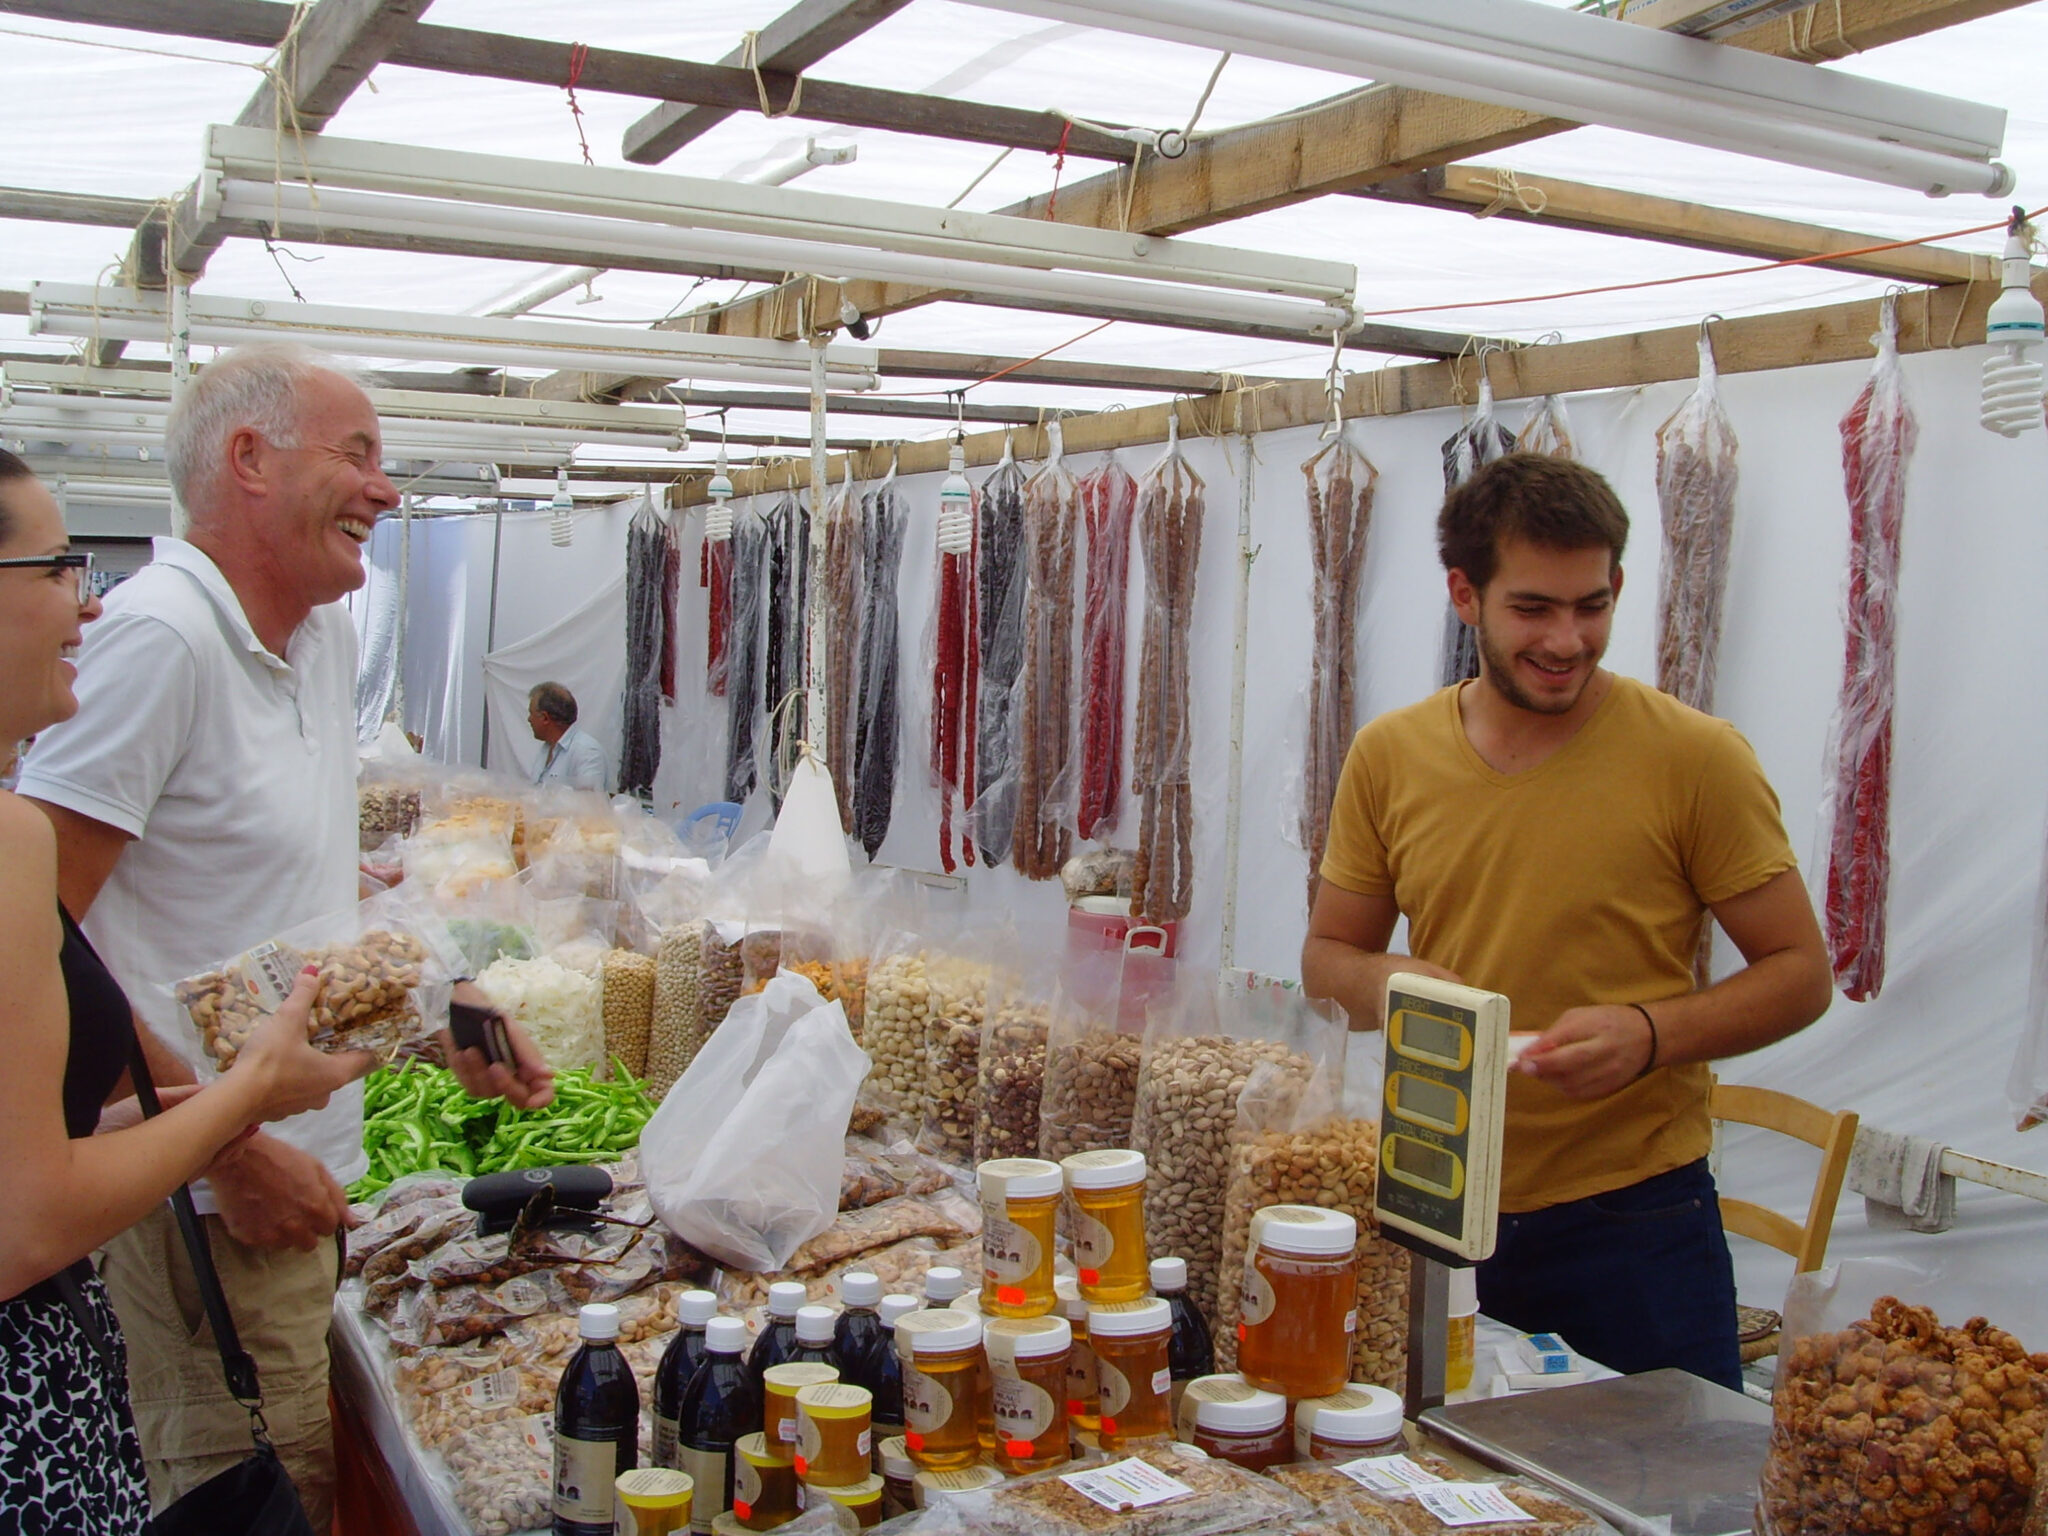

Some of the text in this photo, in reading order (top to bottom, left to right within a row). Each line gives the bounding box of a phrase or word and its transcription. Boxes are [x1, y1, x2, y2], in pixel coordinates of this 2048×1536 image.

[1397, 1058, 1421, 1074] PRICE
[1394, 1120, 1445, 1146] TOTAL PRICE
